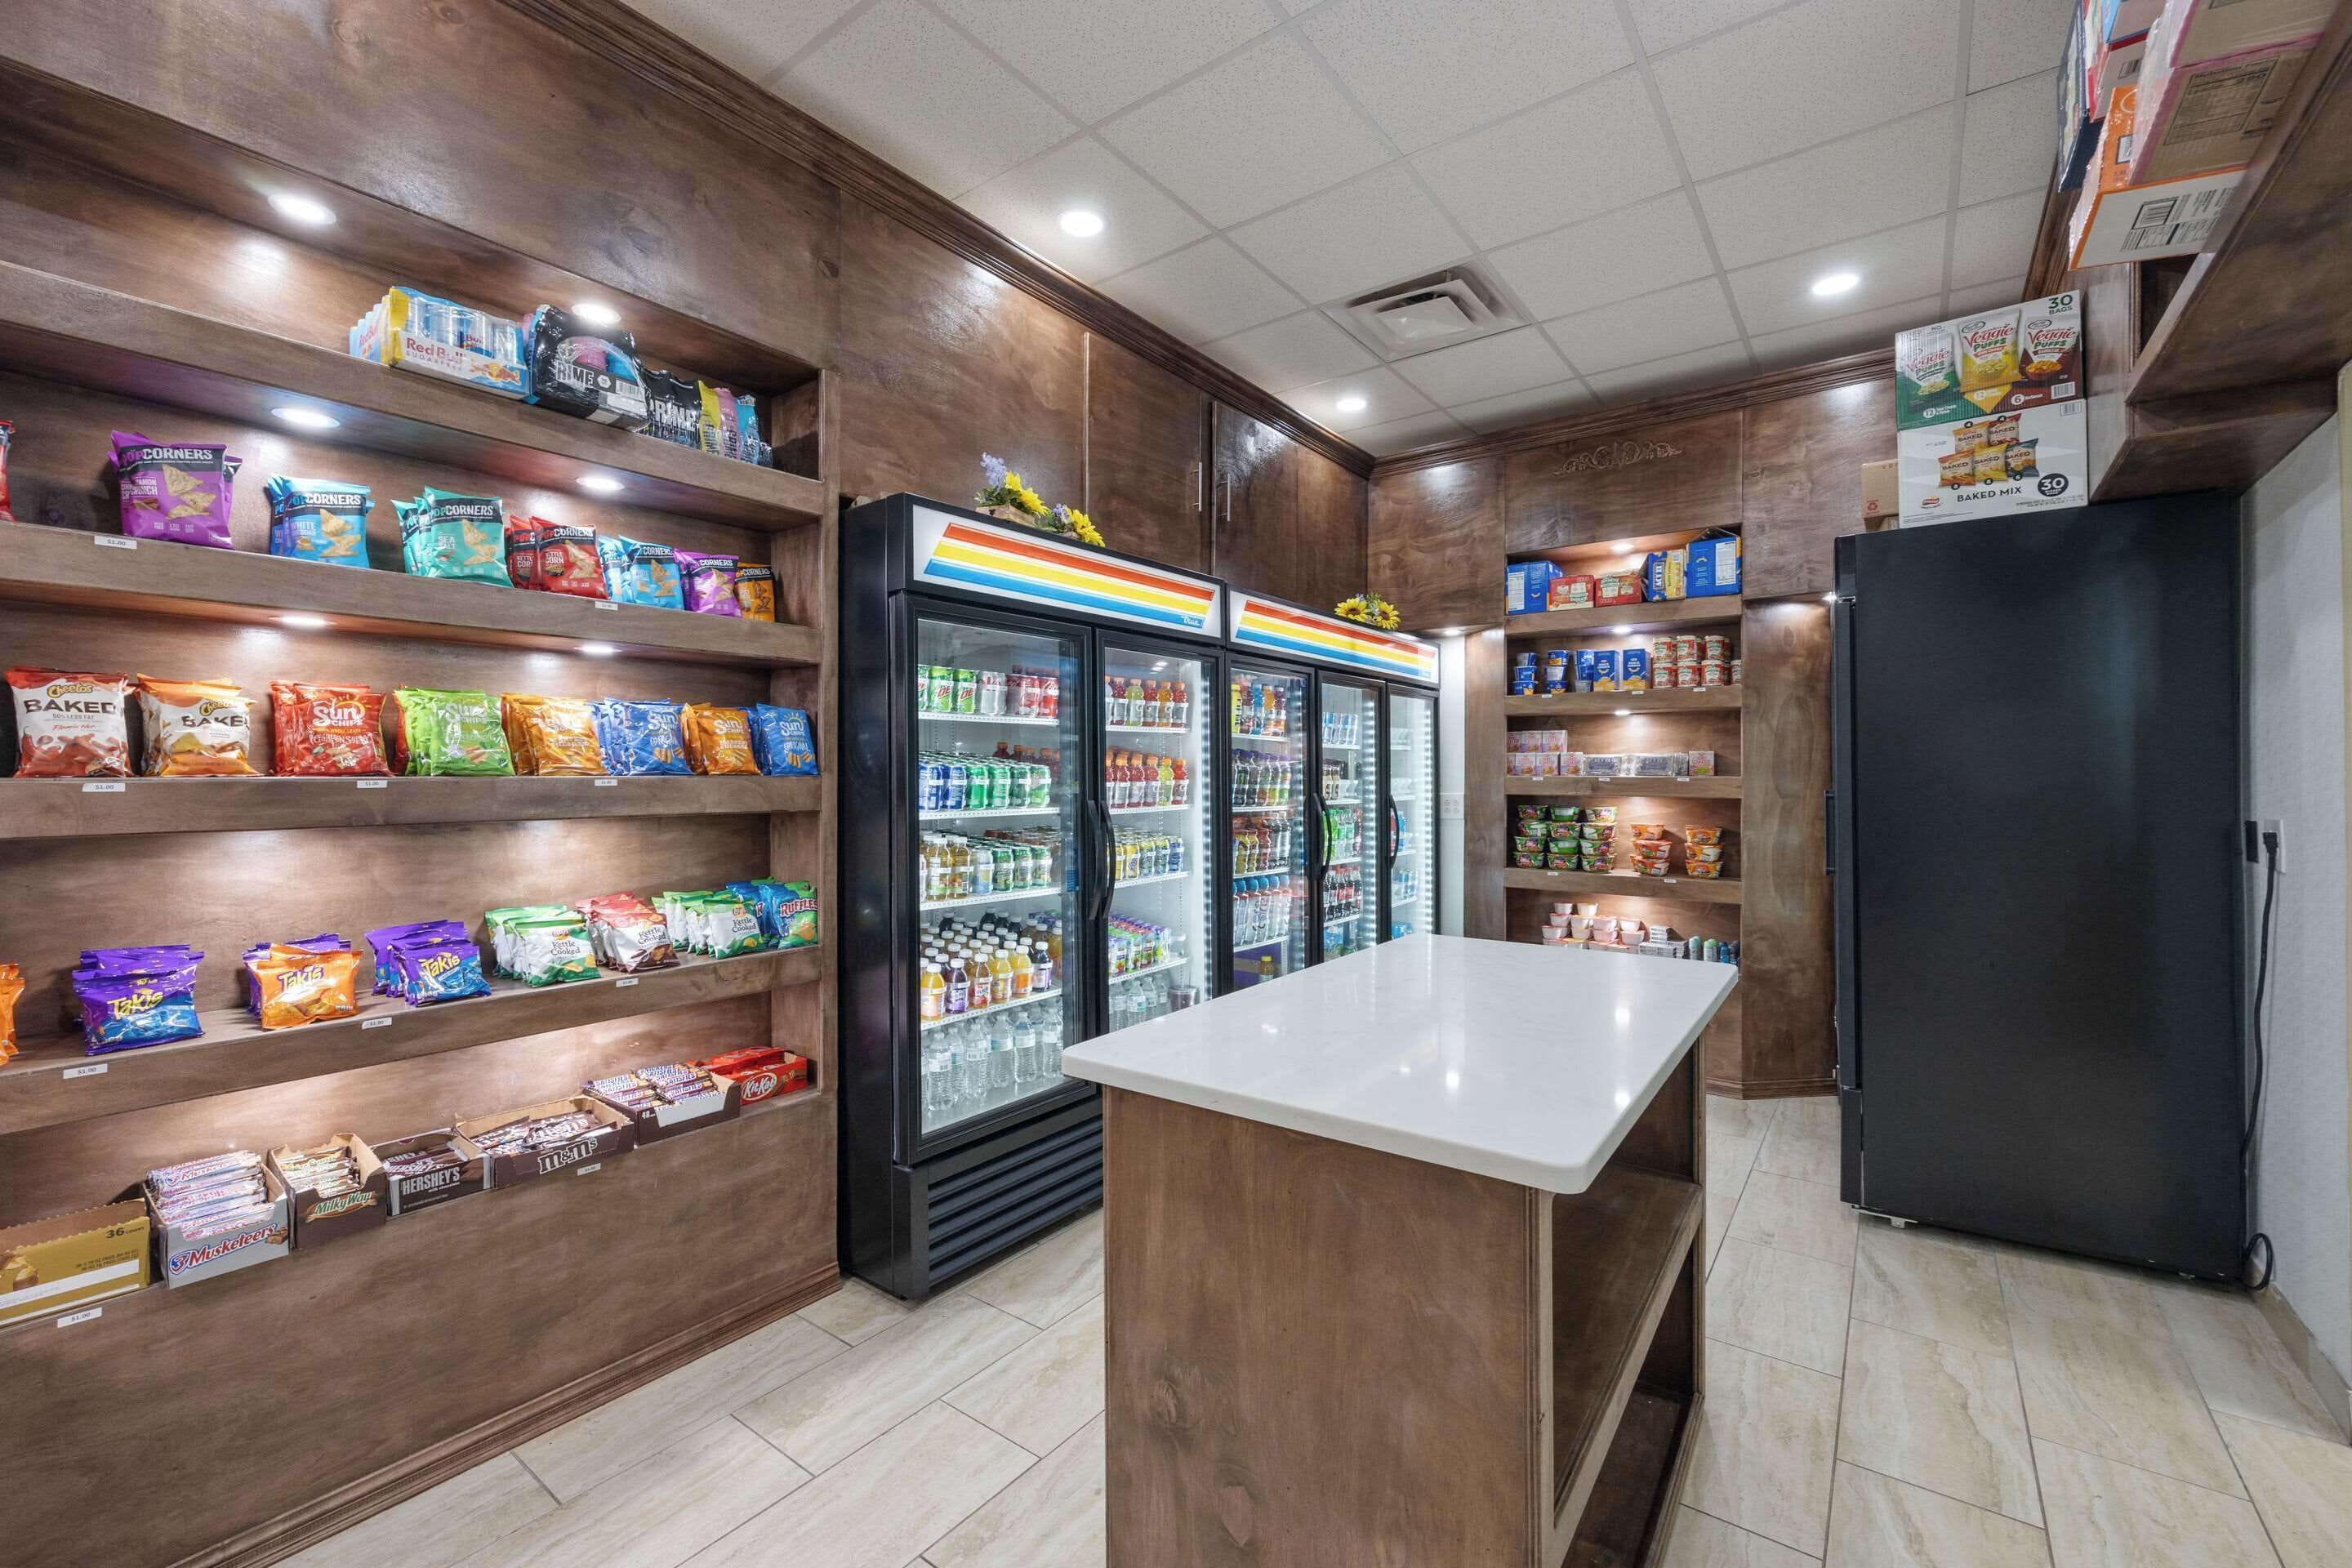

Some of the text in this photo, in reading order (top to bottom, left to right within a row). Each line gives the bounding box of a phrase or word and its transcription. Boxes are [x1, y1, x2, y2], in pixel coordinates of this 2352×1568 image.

[2048, 294, 2074, 309] 30
[2049, 305, 2074, 315] BAGS
[1963, 324, 2013, 348] Veggie
[2028, 329, 2076, 345] Veggie
[406, 336, 435, 356] Red
[1973, 338, 2007, 352] PUFFS
[2034, 340, 2067, 350] PUFFS
[555, 360, 595, 387] RIME
[1989, 426, 2015, 435] BAKED
[1958, 433, 1984, 443] BAKED
[1974, 456, 2000, 465] BAKED
[2005, 451, 2031, 461] BAKED
[1942, 461, 1969, 471] BAKED
[2041, 478, 2066, 490] 30
[1957, 487, 2023, 502] BAKED MIX
[47, 684, 93, 698] Cheetos
[24, 699, 116, 714] BAKED
[313, 699, 362, 726] Sun
[779, 721, 804, 737] Sun
[781, 899, 817, 917] RUFFLES
[732, 915, 753, 925] Kettle
[639, 927, 662, 938] Kettle
[732, 924, 757, 933] Cooked
[550, 947, 581, 956] Cooked
[552, 941, 576, 949] Kettle
[422, 952, 461, 978] Takis
[278, 966, 323, 994] Takis
[107, 991, 163, 1021] Takis
[665, 1072, 696, 1086] SATISFIES
[402, 1166, 461, 1196] HERSHEY'S
[105, 1227, 125, 1239] 36
[176, 1224, 276, 1271] 3 Musketeers
[71, 1312, 91, 1321] $1.00
